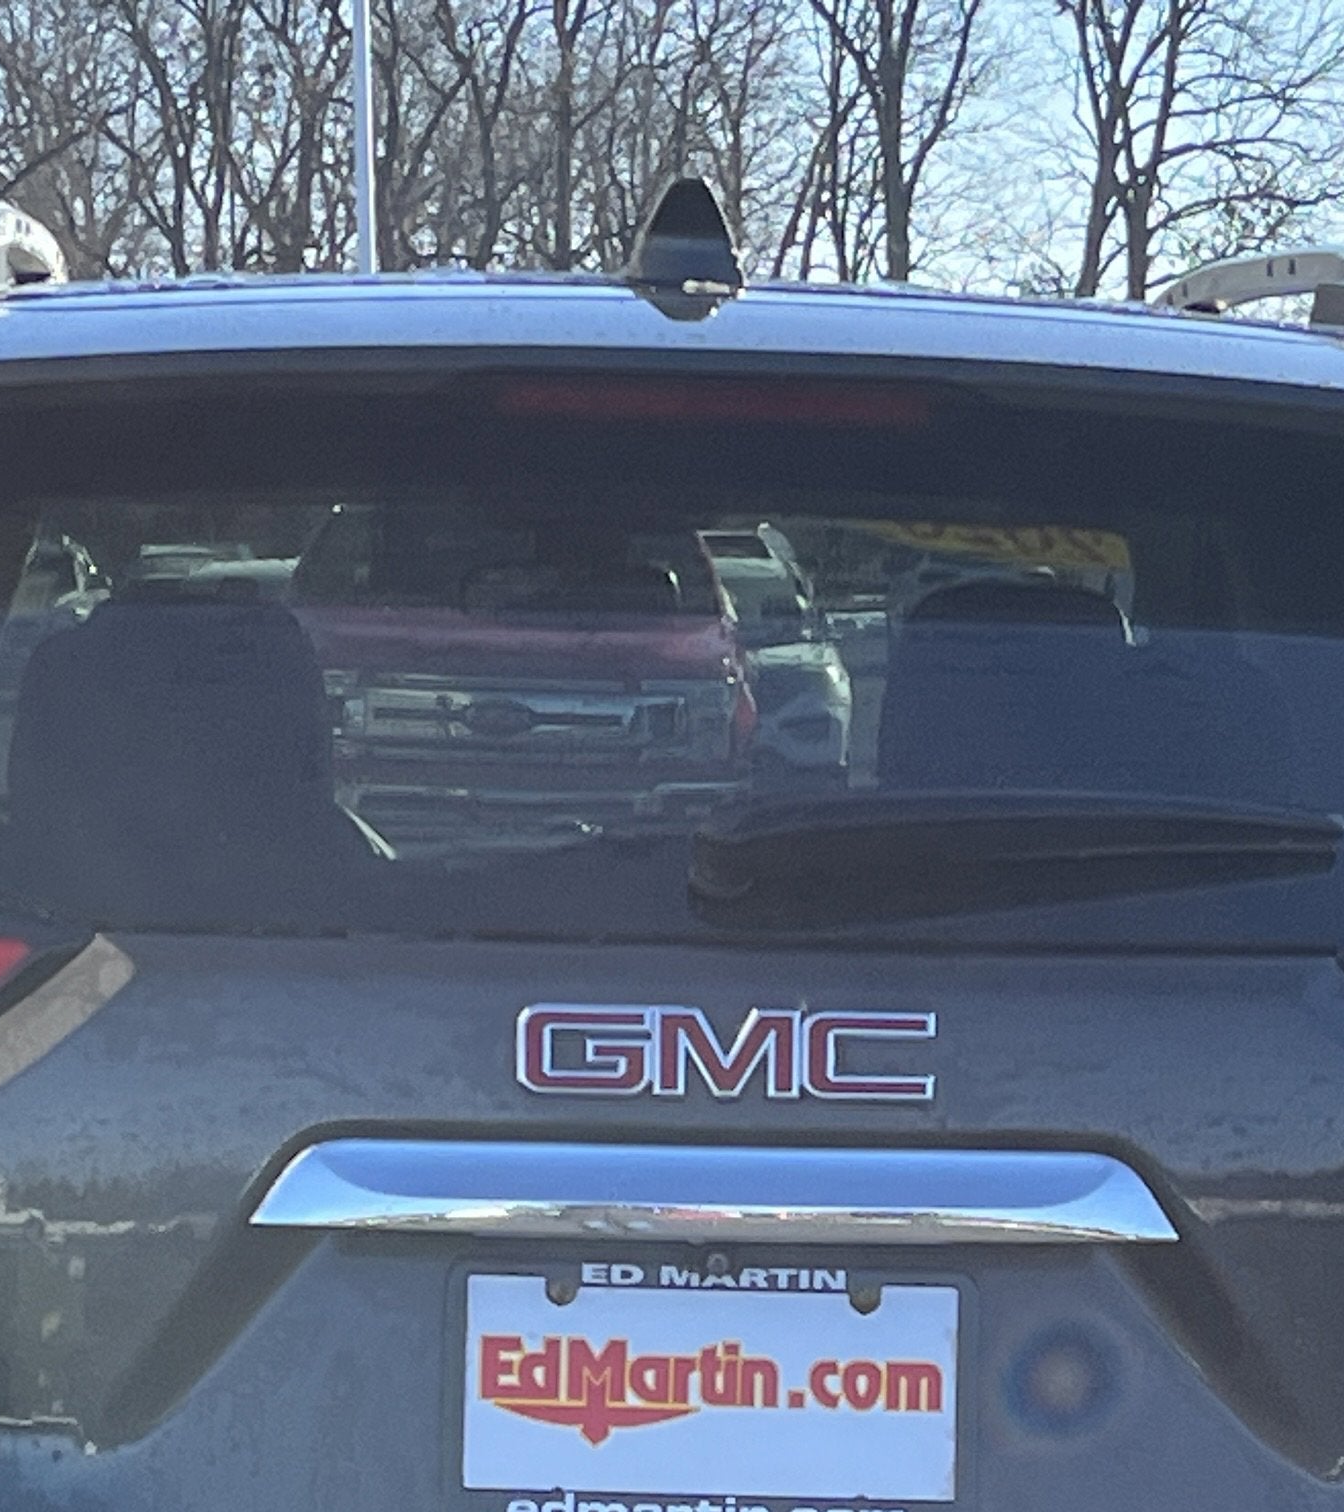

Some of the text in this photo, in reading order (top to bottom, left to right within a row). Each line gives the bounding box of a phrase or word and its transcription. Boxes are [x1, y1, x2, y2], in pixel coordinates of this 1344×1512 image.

[516, 1003, 937, 1099] GMC
[581, 1263, 847, 1290] ED MARTIN
[479, 1334, 943, 1413] EdMartin.com
